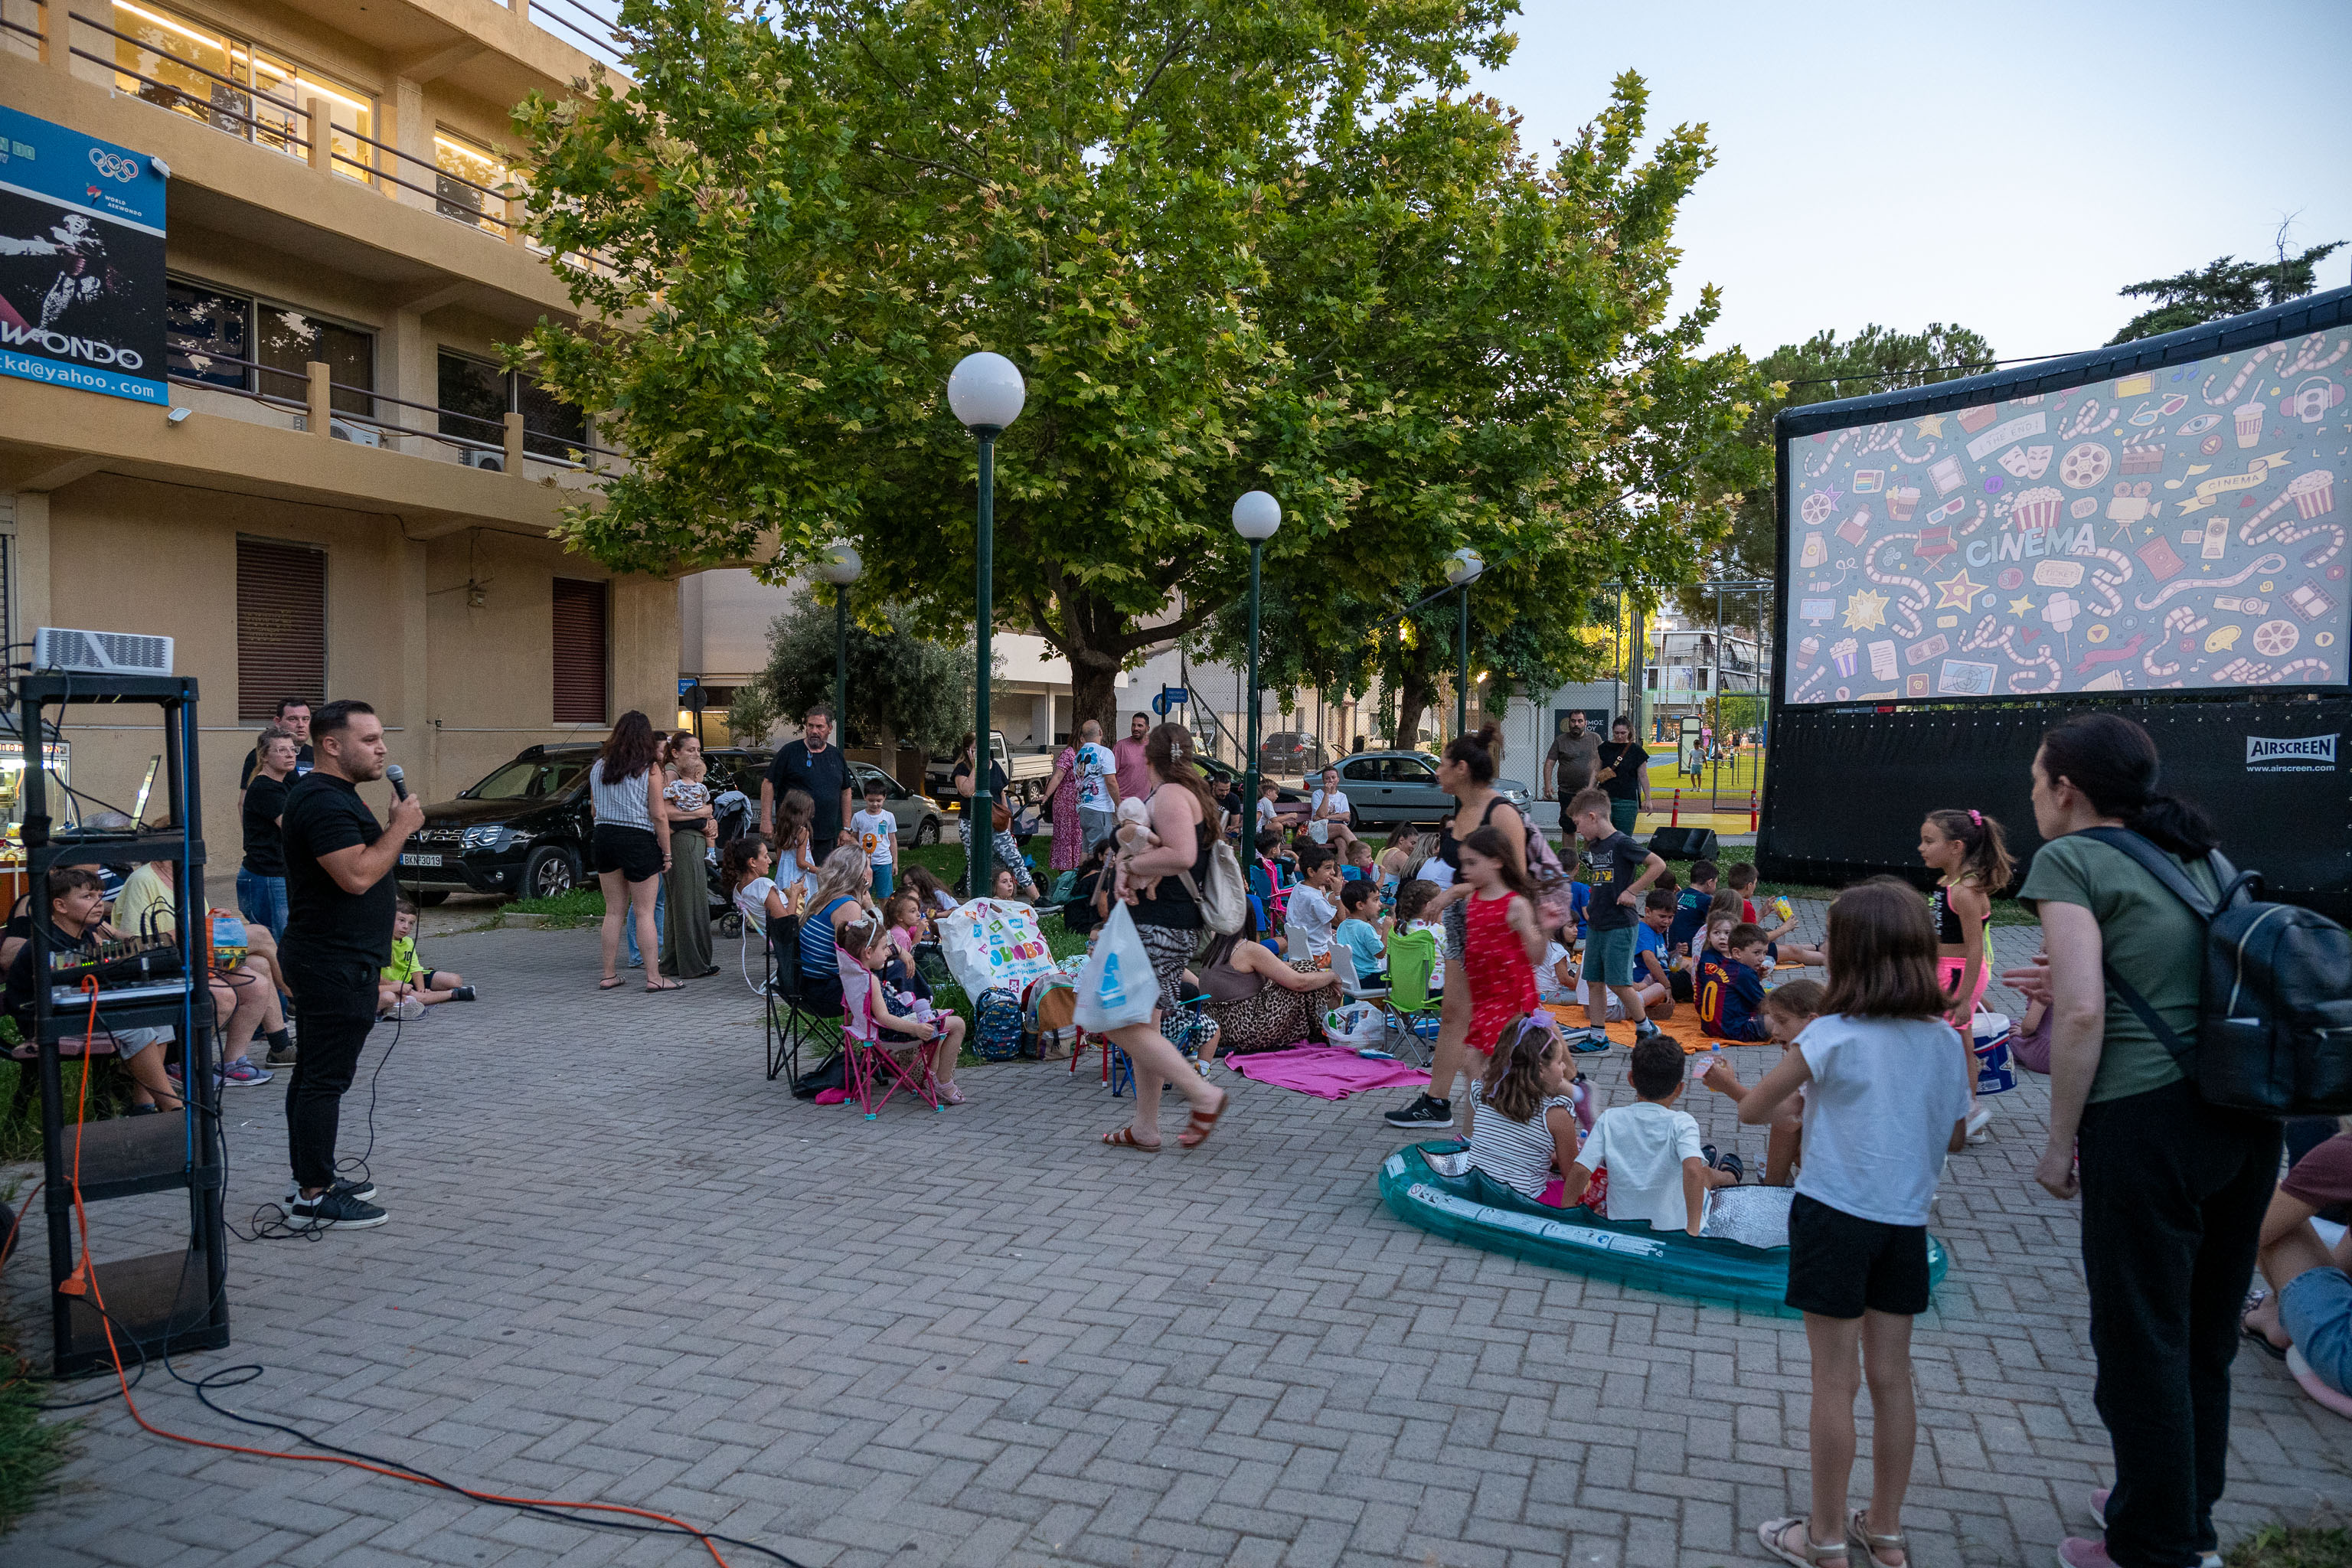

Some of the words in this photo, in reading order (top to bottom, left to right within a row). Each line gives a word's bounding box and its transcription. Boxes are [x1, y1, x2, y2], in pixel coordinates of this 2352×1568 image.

[105, 195, 126, 205] WORLD
[0, 355, 154, 397] kd@yahoo.com
[1986, 433, 2004, 446] THE
[2011, 423, 2032, 436] END
[2208, 474, 2259, 490] CINEMA
[2074, 501, 2094, 515] HD
[1965, 523, 2096, 567] CINEMA
[2251, 738, 2331, 757] AIRSCREEN
